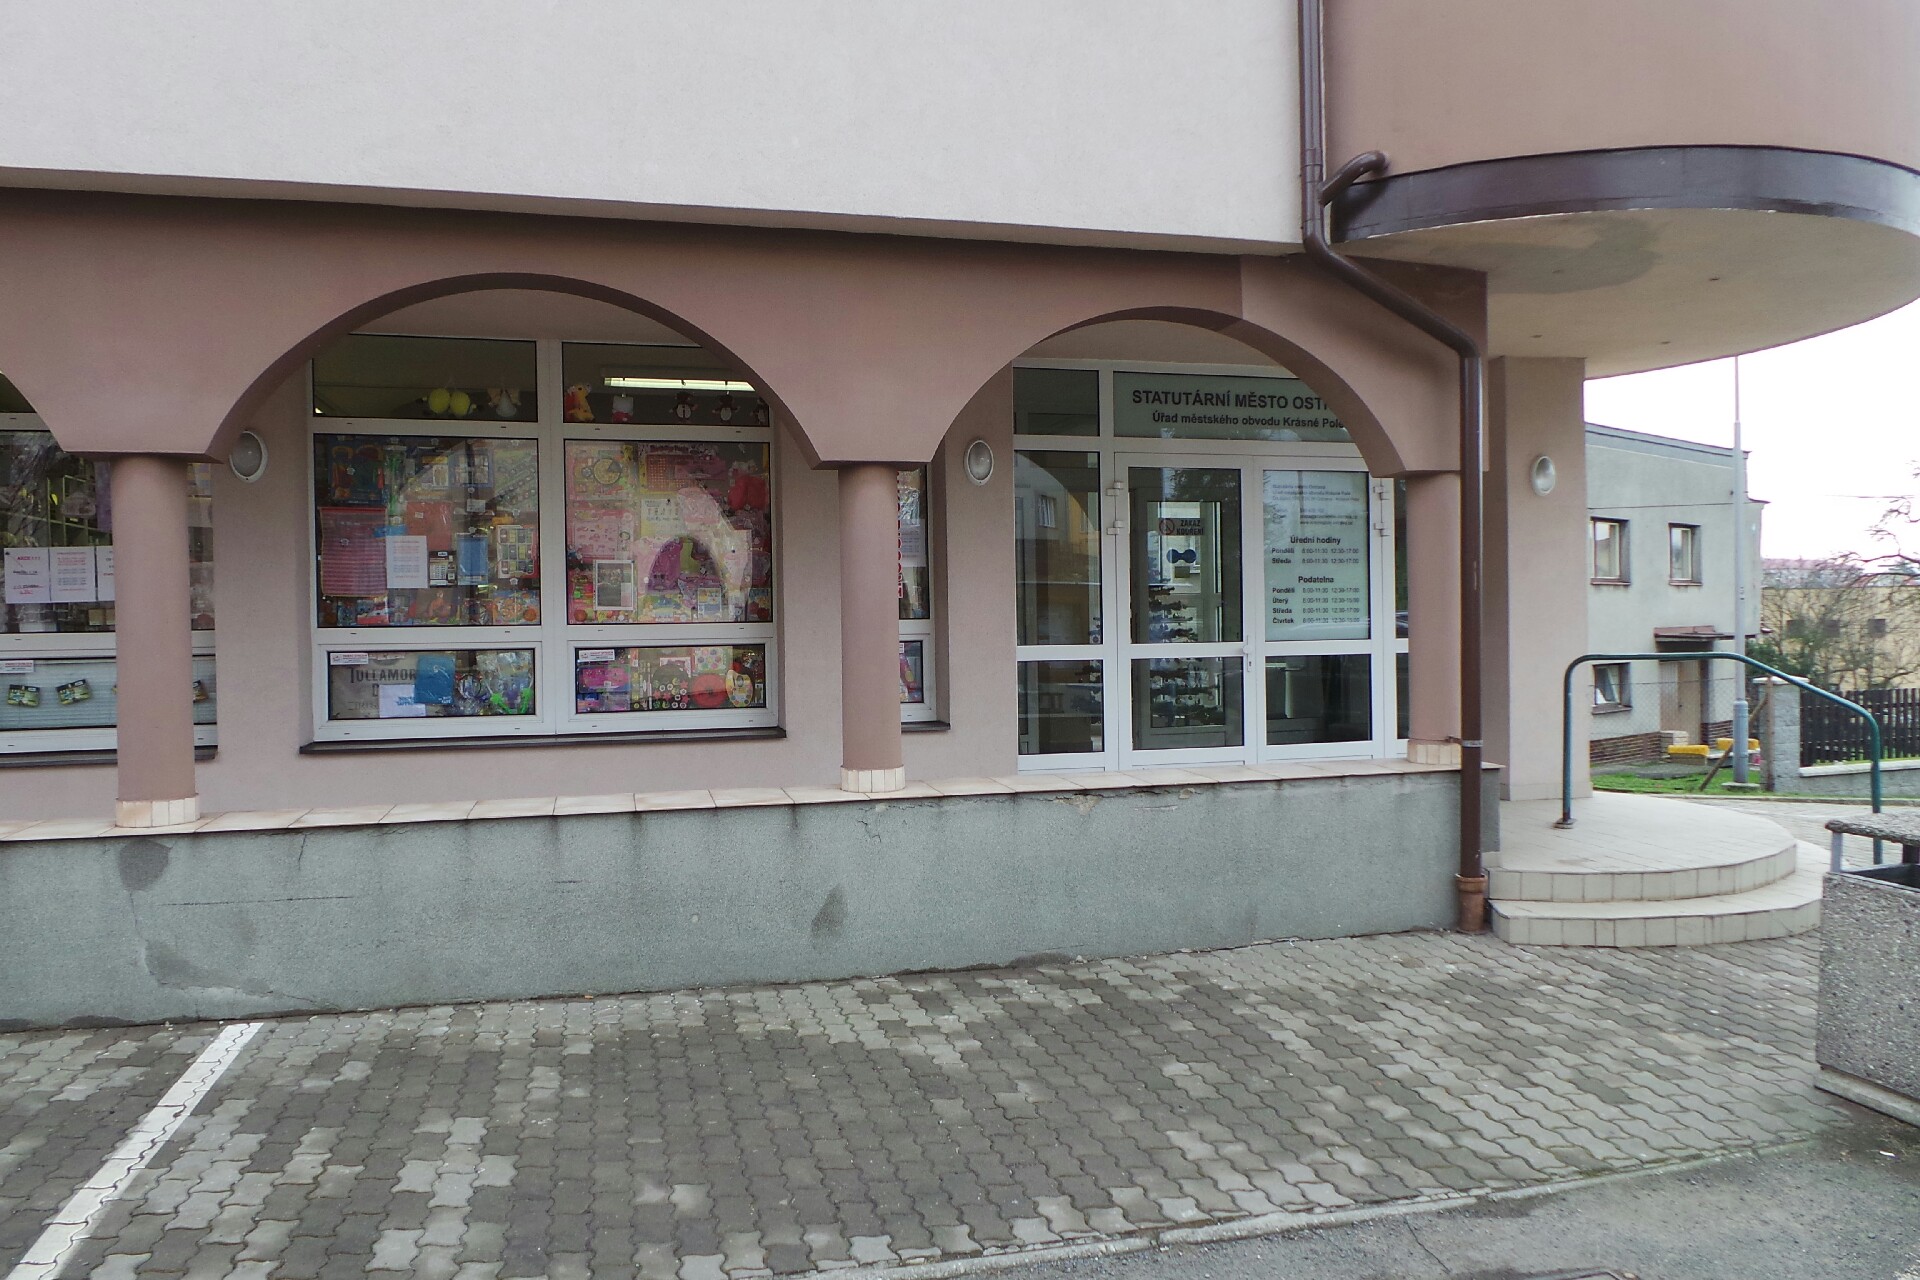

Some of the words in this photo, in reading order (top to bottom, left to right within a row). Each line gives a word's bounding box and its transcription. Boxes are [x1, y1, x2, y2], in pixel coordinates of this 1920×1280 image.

[1132, 389, 1231, 406] STATUTÁRNÍ
[1235, 392, 1288, 409] MĚSTO
[1152, 410, 1178, 423] Úřad
[1181, 413, 1238, 425] městského
[1242, 416, 1280, 426] obvodu
[1283, 417, 1319, 427] Krásné
[1290, 535, 1315, 544] Úřední
[1316, 536, 1341, 546] hodiny
[1298, 576, 1334, 584] Podatelna
[1272, 596, 1288, 604] Úterý
[349, 667, 417, 683] TULLAMOR
